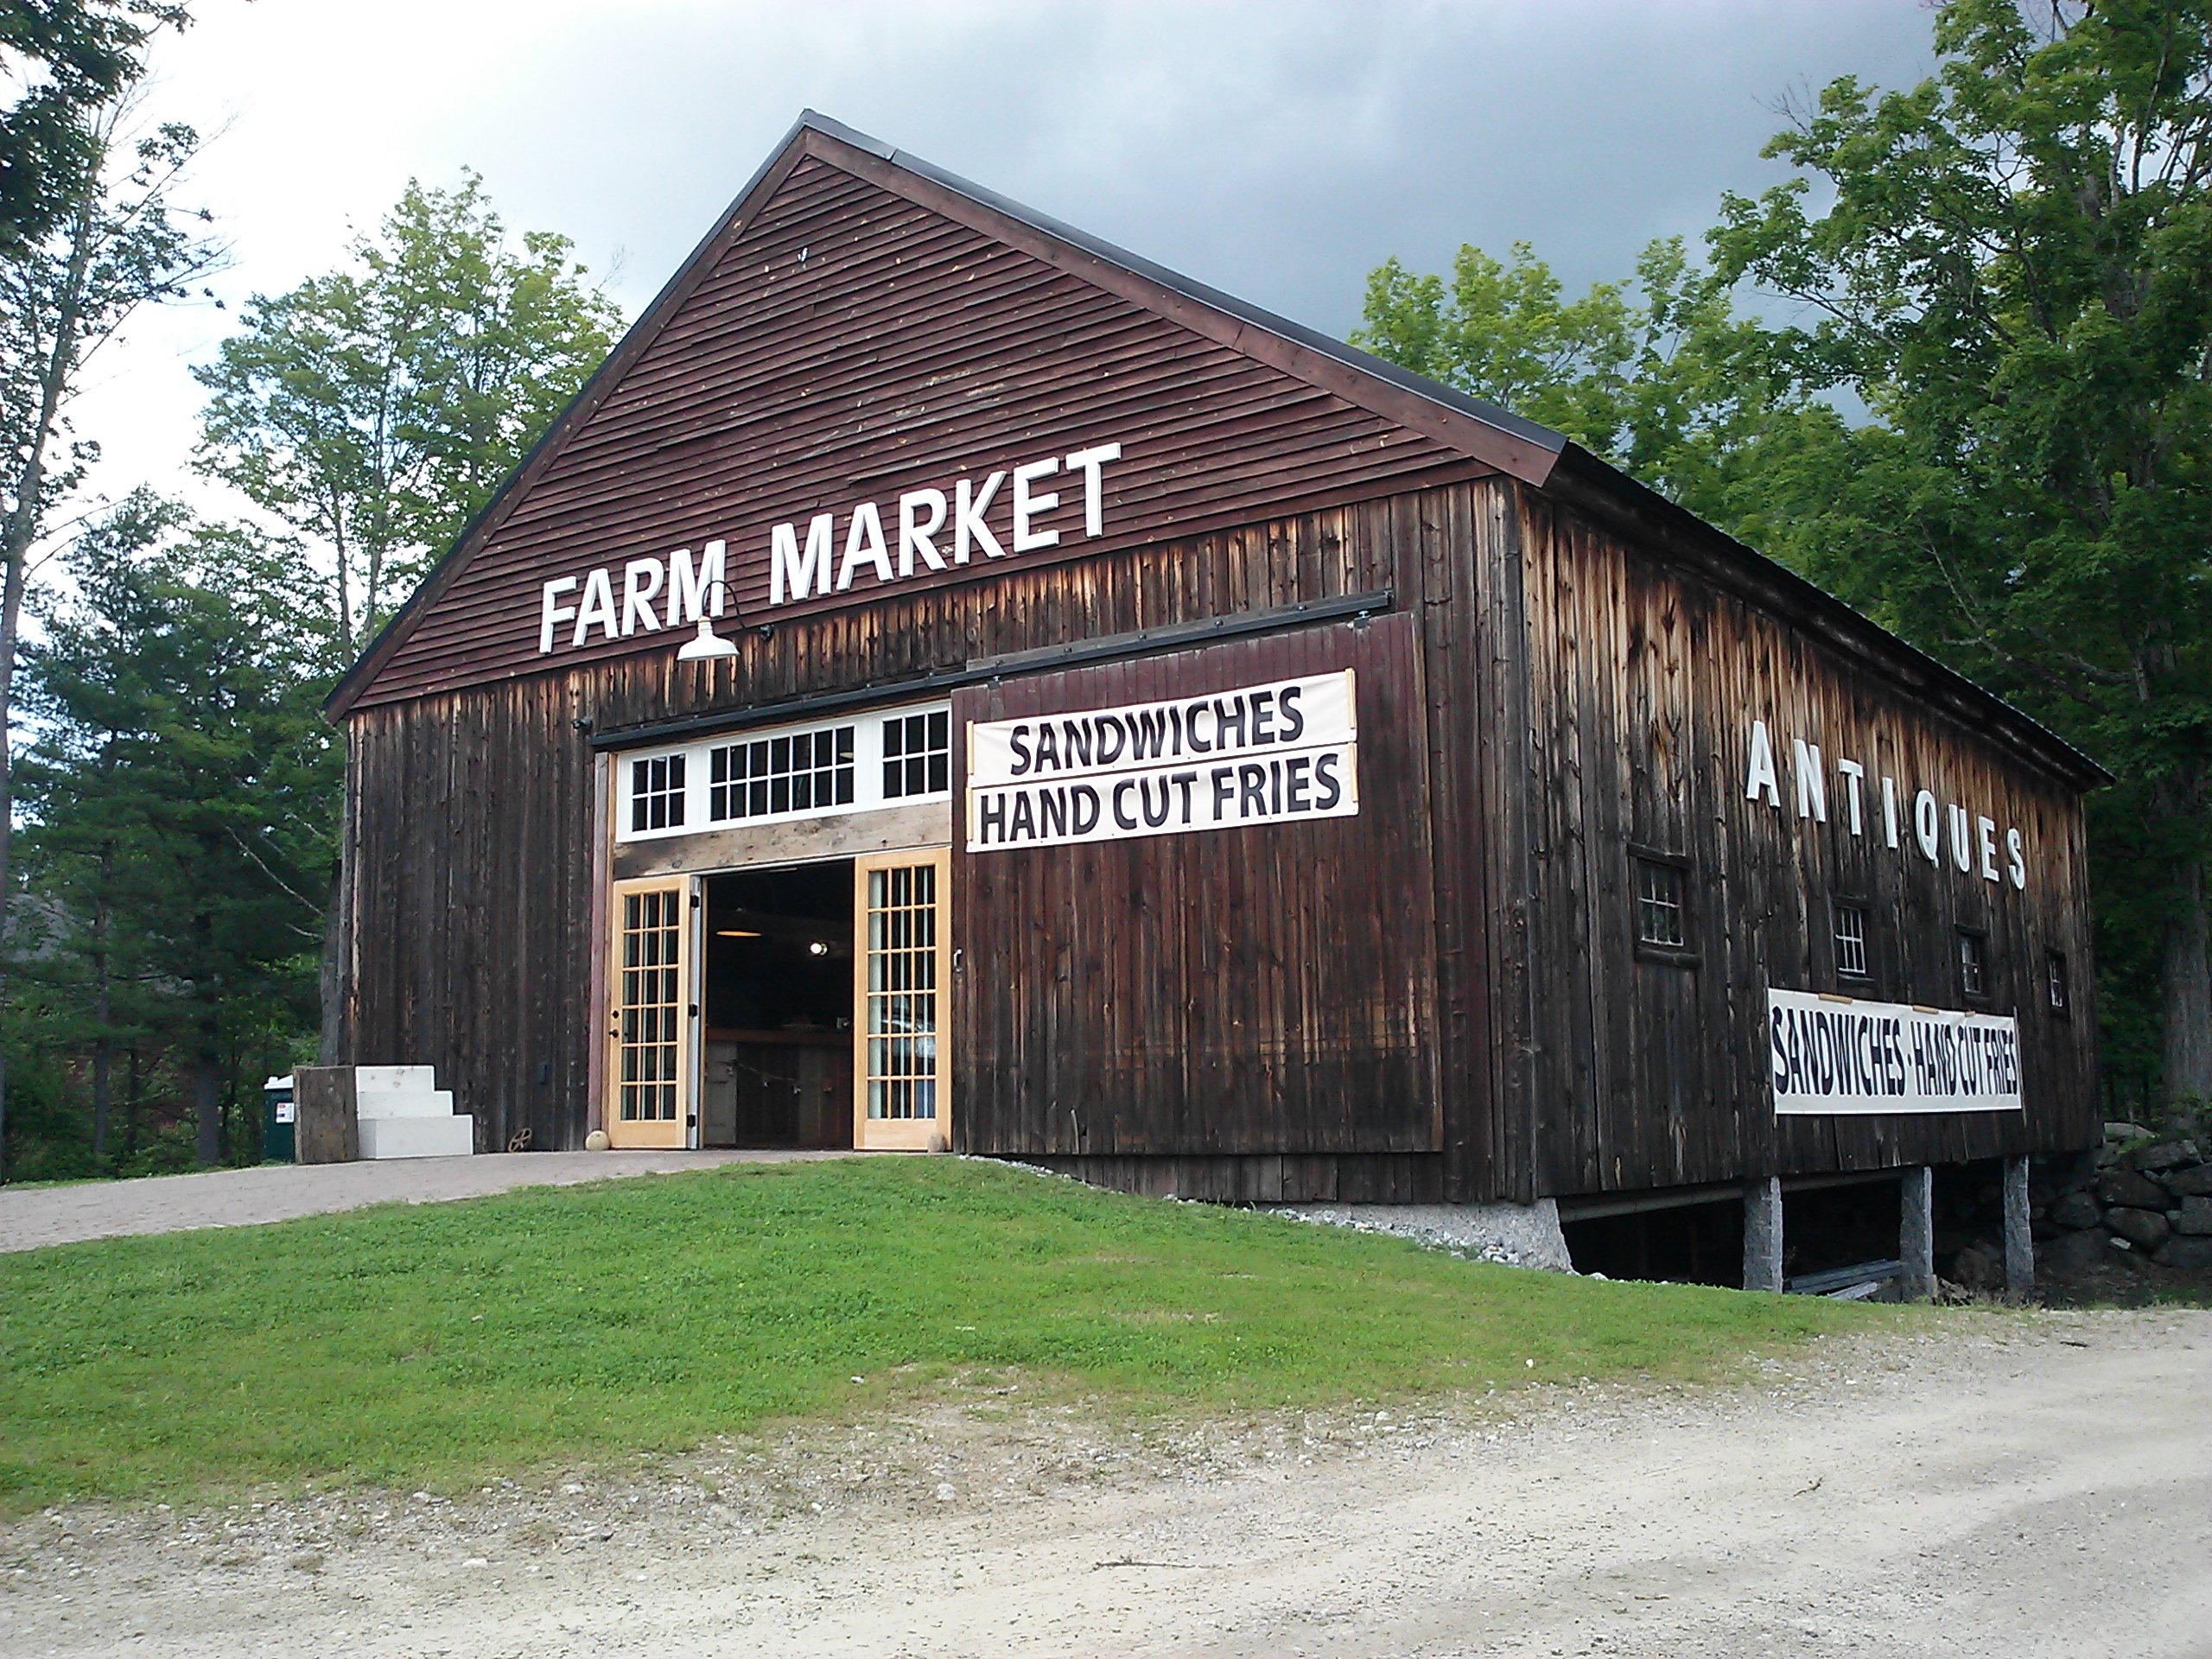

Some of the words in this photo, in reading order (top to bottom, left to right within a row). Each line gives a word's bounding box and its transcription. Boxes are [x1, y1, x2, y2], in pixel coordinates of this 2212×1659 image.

[539, 539, 727, 654] FARM
[770, 442, 1122, 604] MARKET
[1011, 686, 1303, 775] SANDWICHES
[981, 782, 1100, 844] HAND
[1112, 772, 1198, 830] CUT
[1212, 753, 1341, 820] FRIES
[1745, 720, 2025, 890] ANTIQUES
[1772, 1006, 1906, 1096] SANDWICHES
[1910, 1020, 1956, 1096] HAND
[1957, 1027, 1985, 1096] CUT
[1984, 1028, 2018, 1096] FRIES
